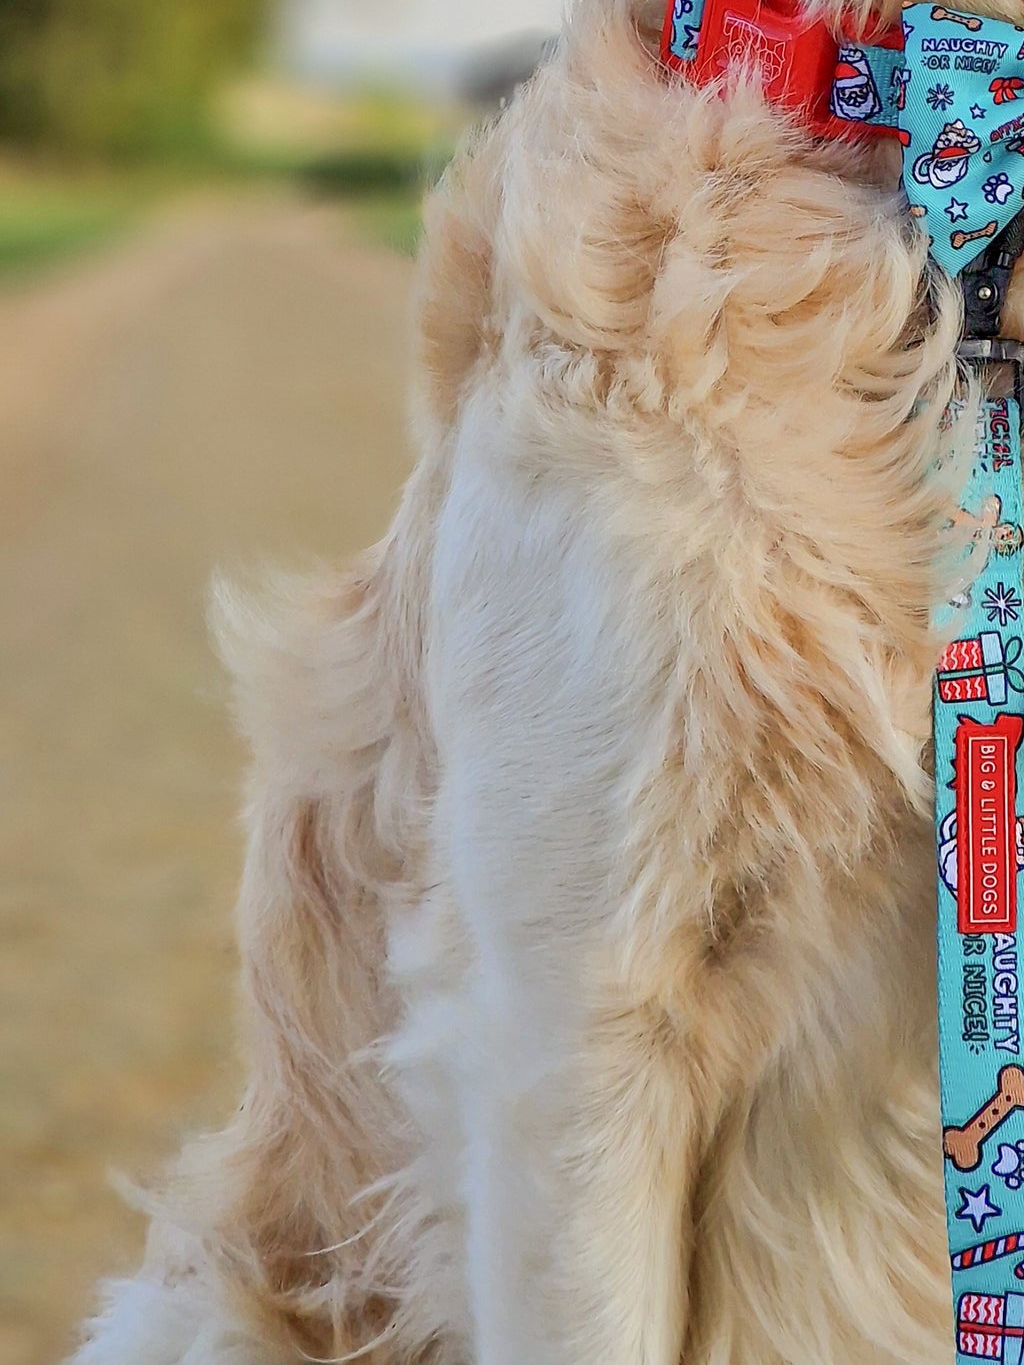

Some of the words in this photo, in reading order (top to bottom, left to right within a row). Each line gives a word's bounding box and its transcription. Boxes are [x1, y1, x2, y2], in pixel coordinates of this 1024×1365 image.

[922, 38, 1009, 58] NAUGHTY
[927, 55, 950, 70] OR
[980, 744, 998, 773] BIG
[981, 779, 995, 791] &
[980, 798, 997, 855] LITTLE
[981, 862, 999, 915] DOGS
[963, 933, 987, 956] R
[962, 964, 990, 1042] NICE!
